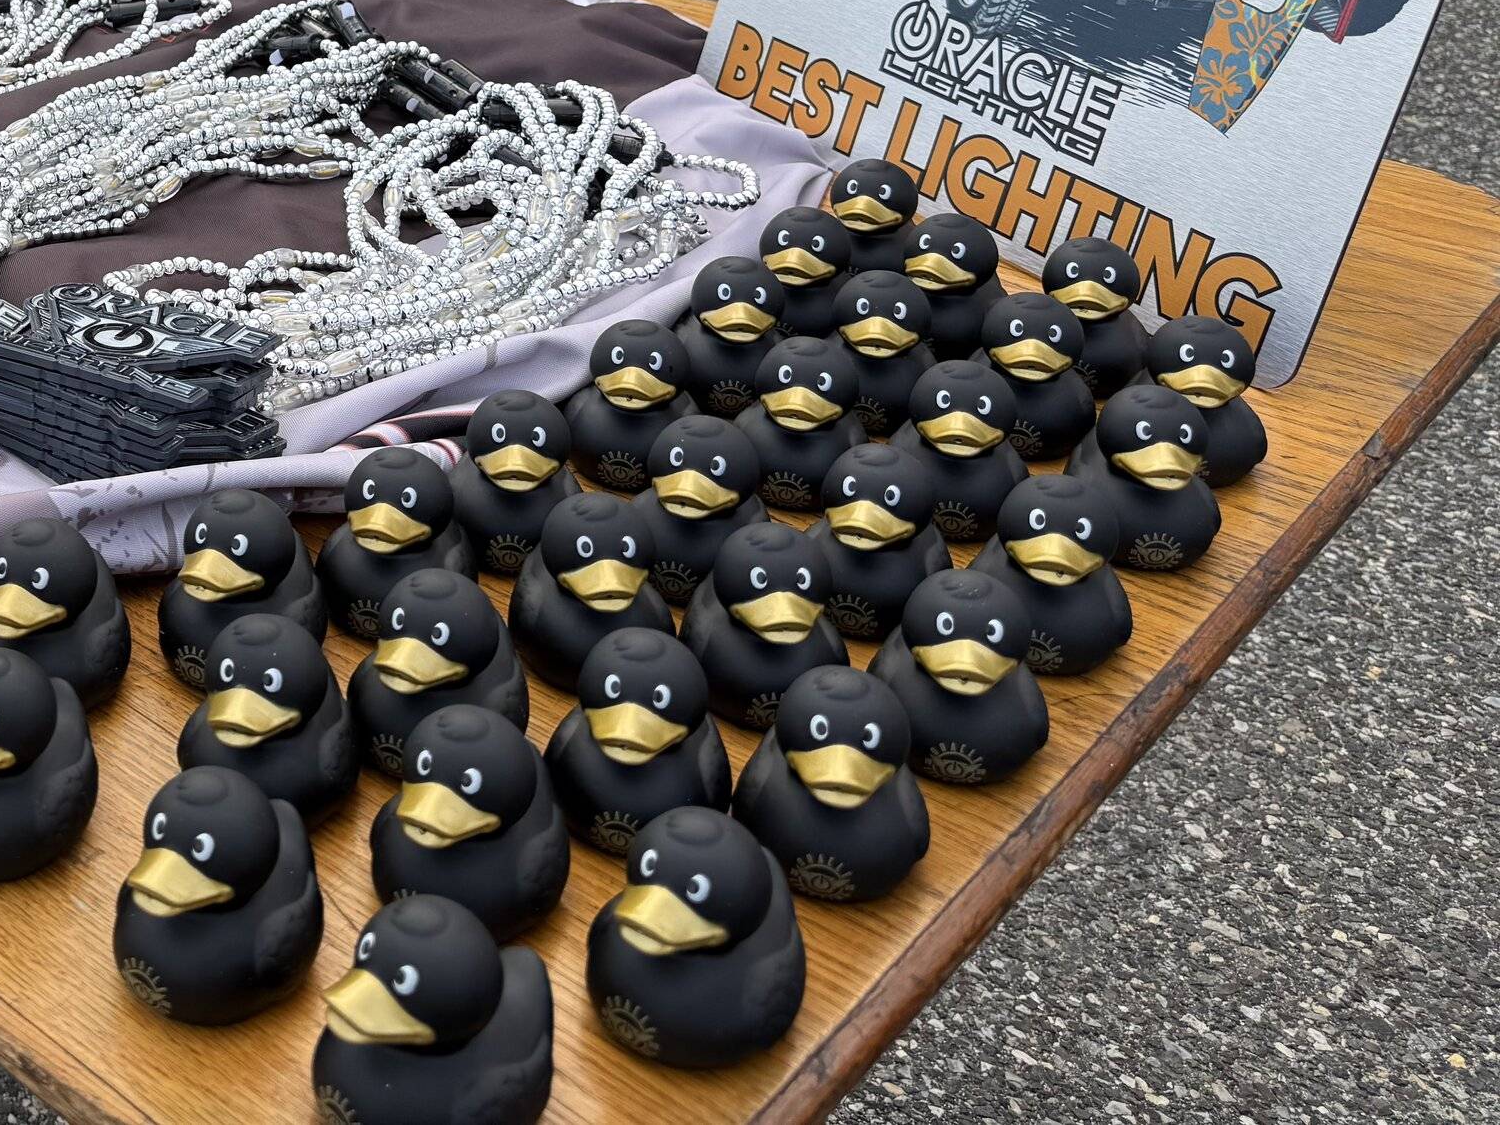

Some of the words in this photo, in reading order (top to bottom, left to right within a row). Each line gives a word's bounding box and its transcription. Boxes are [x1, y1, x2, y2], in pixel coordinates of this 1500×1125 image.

[715, 20, 884, 156] BEST
[879, 48, 1107, 166] LIGHTING
[52, 283, 274, 353] ORACLE
